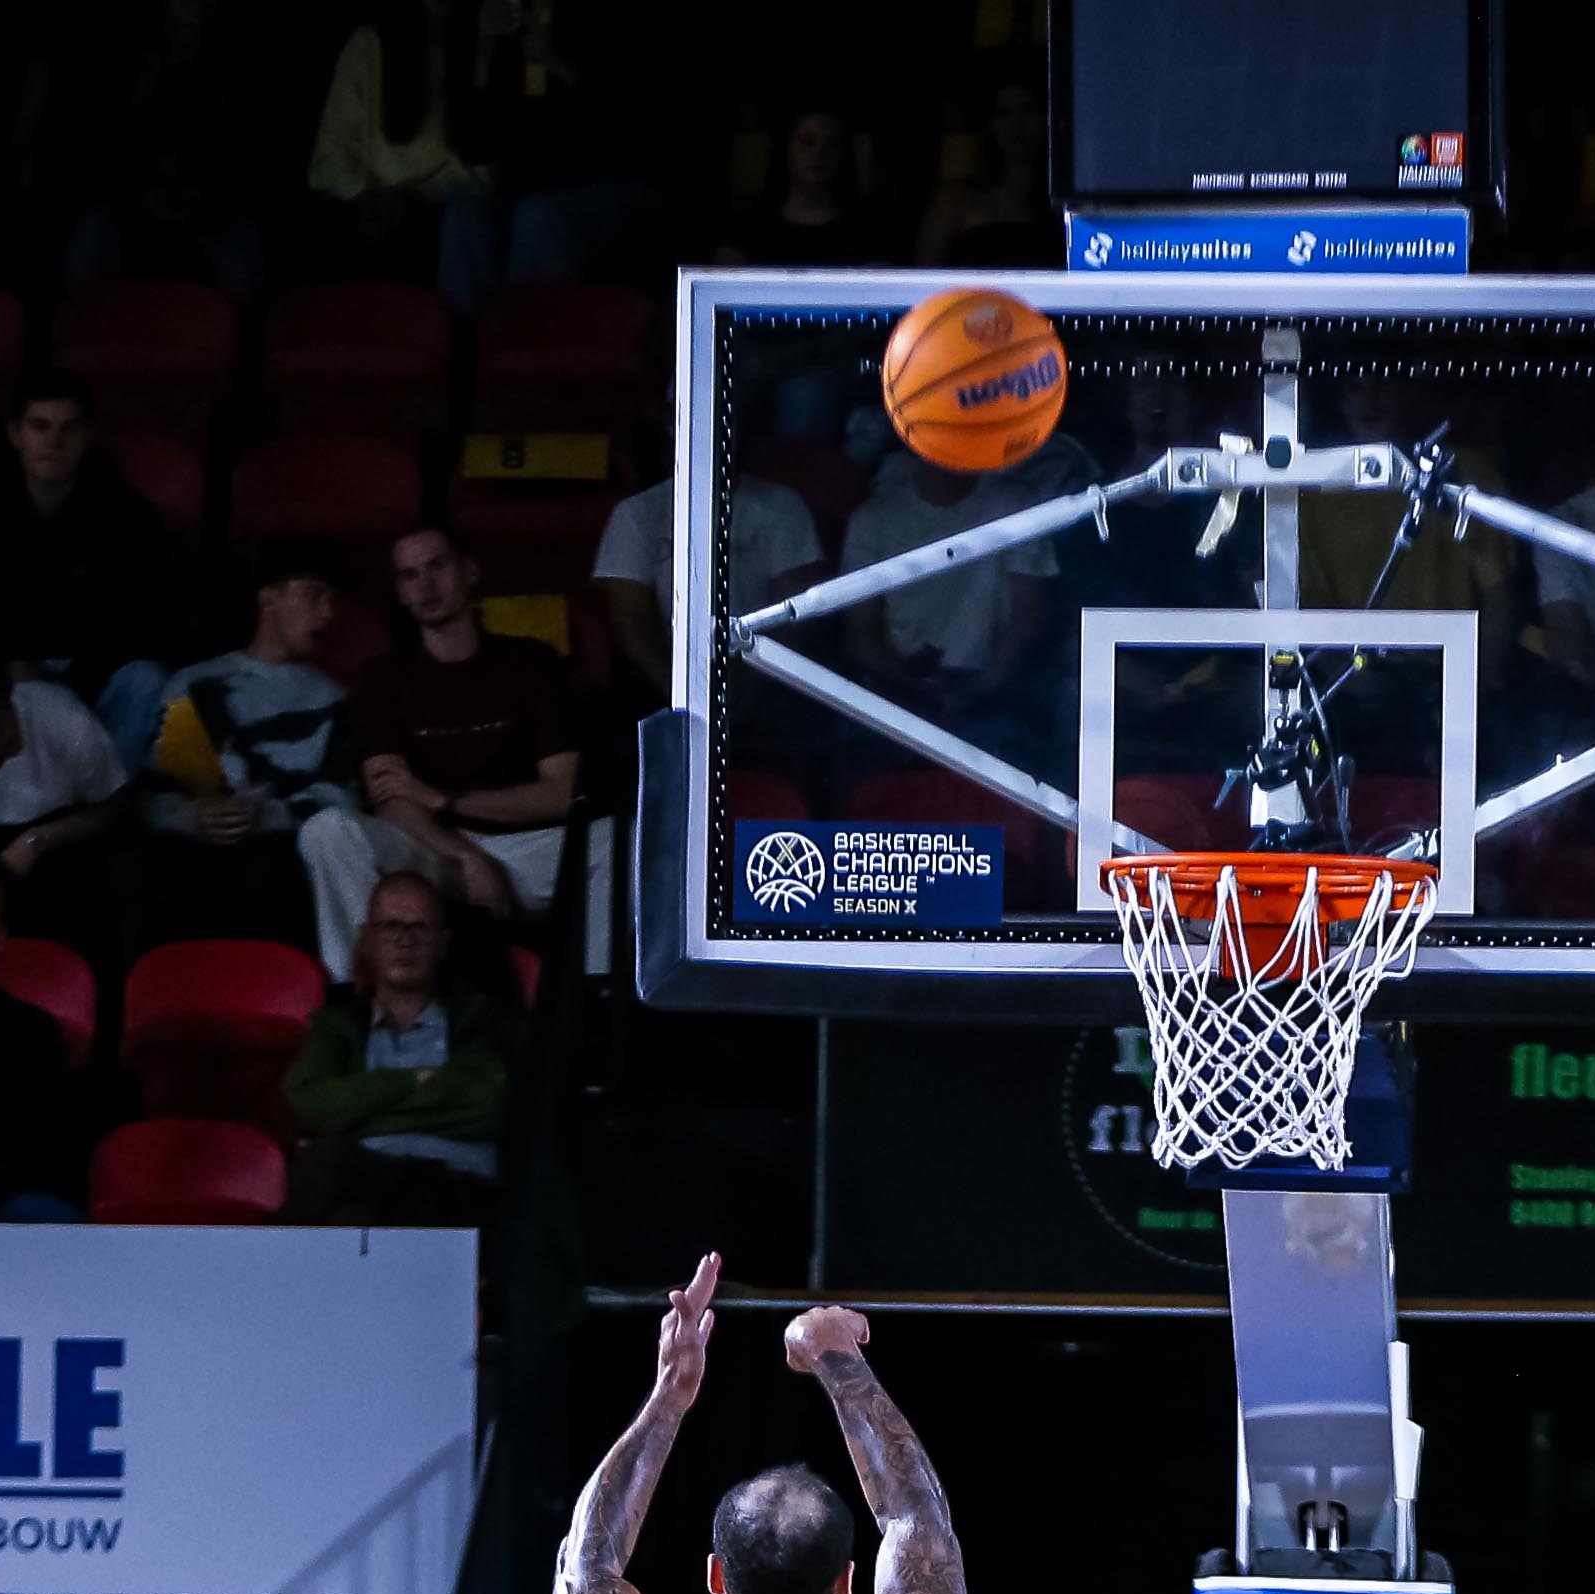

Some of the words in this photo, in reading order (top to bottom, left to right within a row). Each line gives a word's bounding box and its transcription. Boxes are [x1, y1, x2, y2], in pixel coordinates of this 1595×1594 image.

[1121, 239, 1252, 263] holidaysuites
[1324, 237, 1456, 261] holidaysuites
[833, 831, 975, 852] BASKETBALL
[833, 852, 992, 876] CHAMPIONS
[833, 874, 918, 894] LEAGUE
[833, 898, 901, 915] SEASON
[903, 899, 917, 915] X
